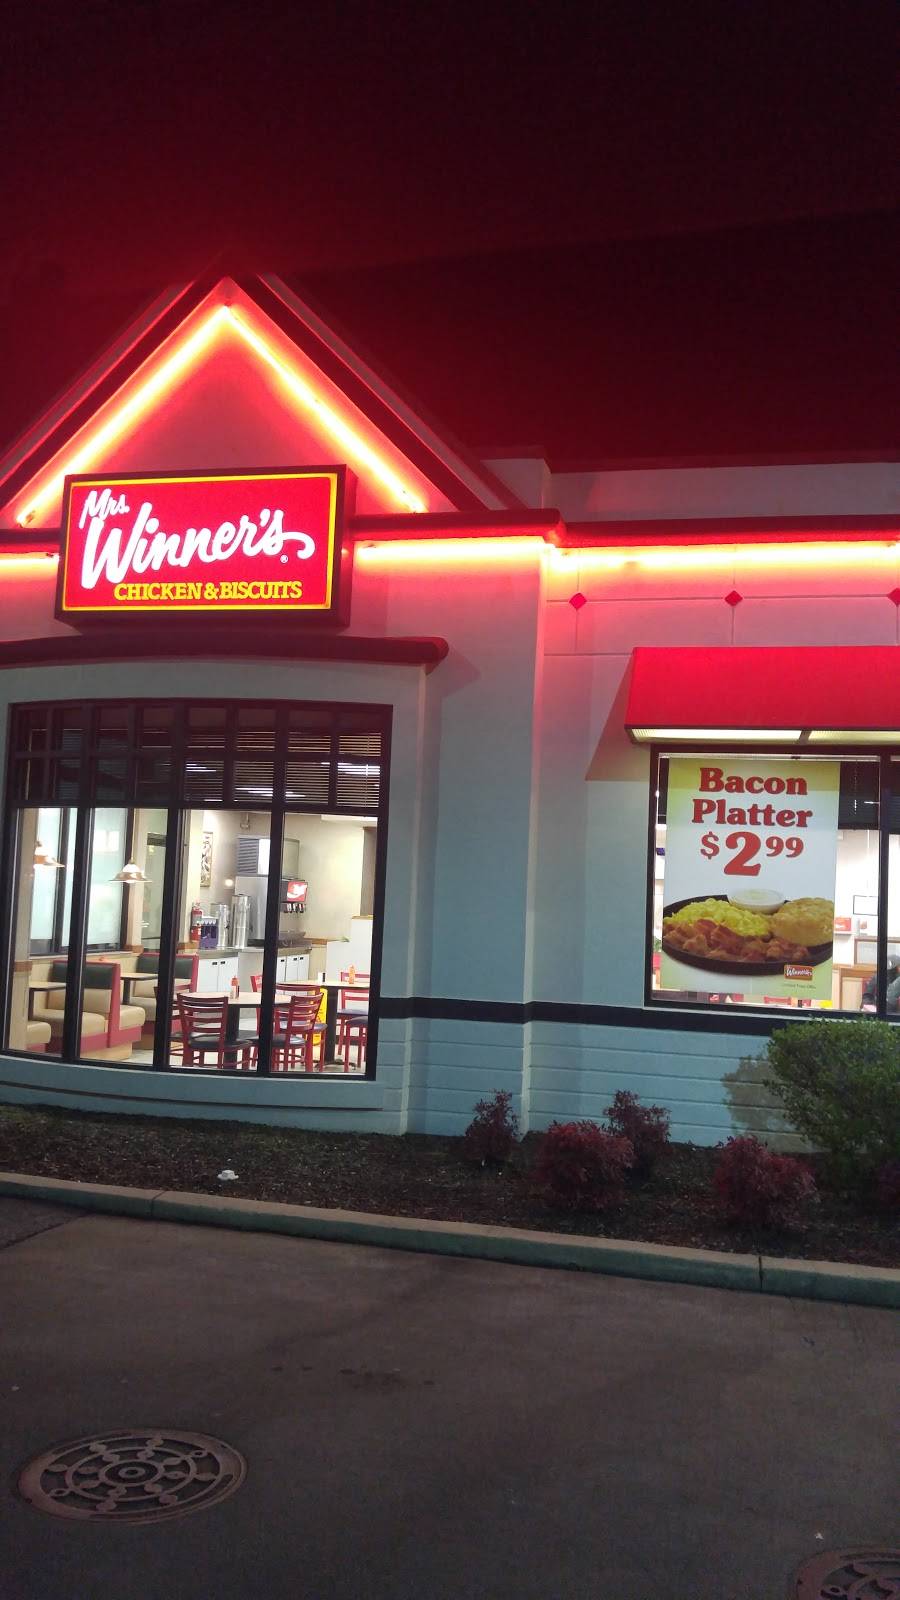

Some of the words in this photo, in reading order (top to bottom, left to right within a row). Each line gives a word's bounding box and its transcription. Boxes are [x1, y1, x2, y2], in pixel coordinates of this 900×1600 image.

[79, 488, 130, 529] Mrs.
[81, 501, 315, 589] Winner's
[699, 767, 807, 795] Bacon
[691, 798, 813, 828] Platter
